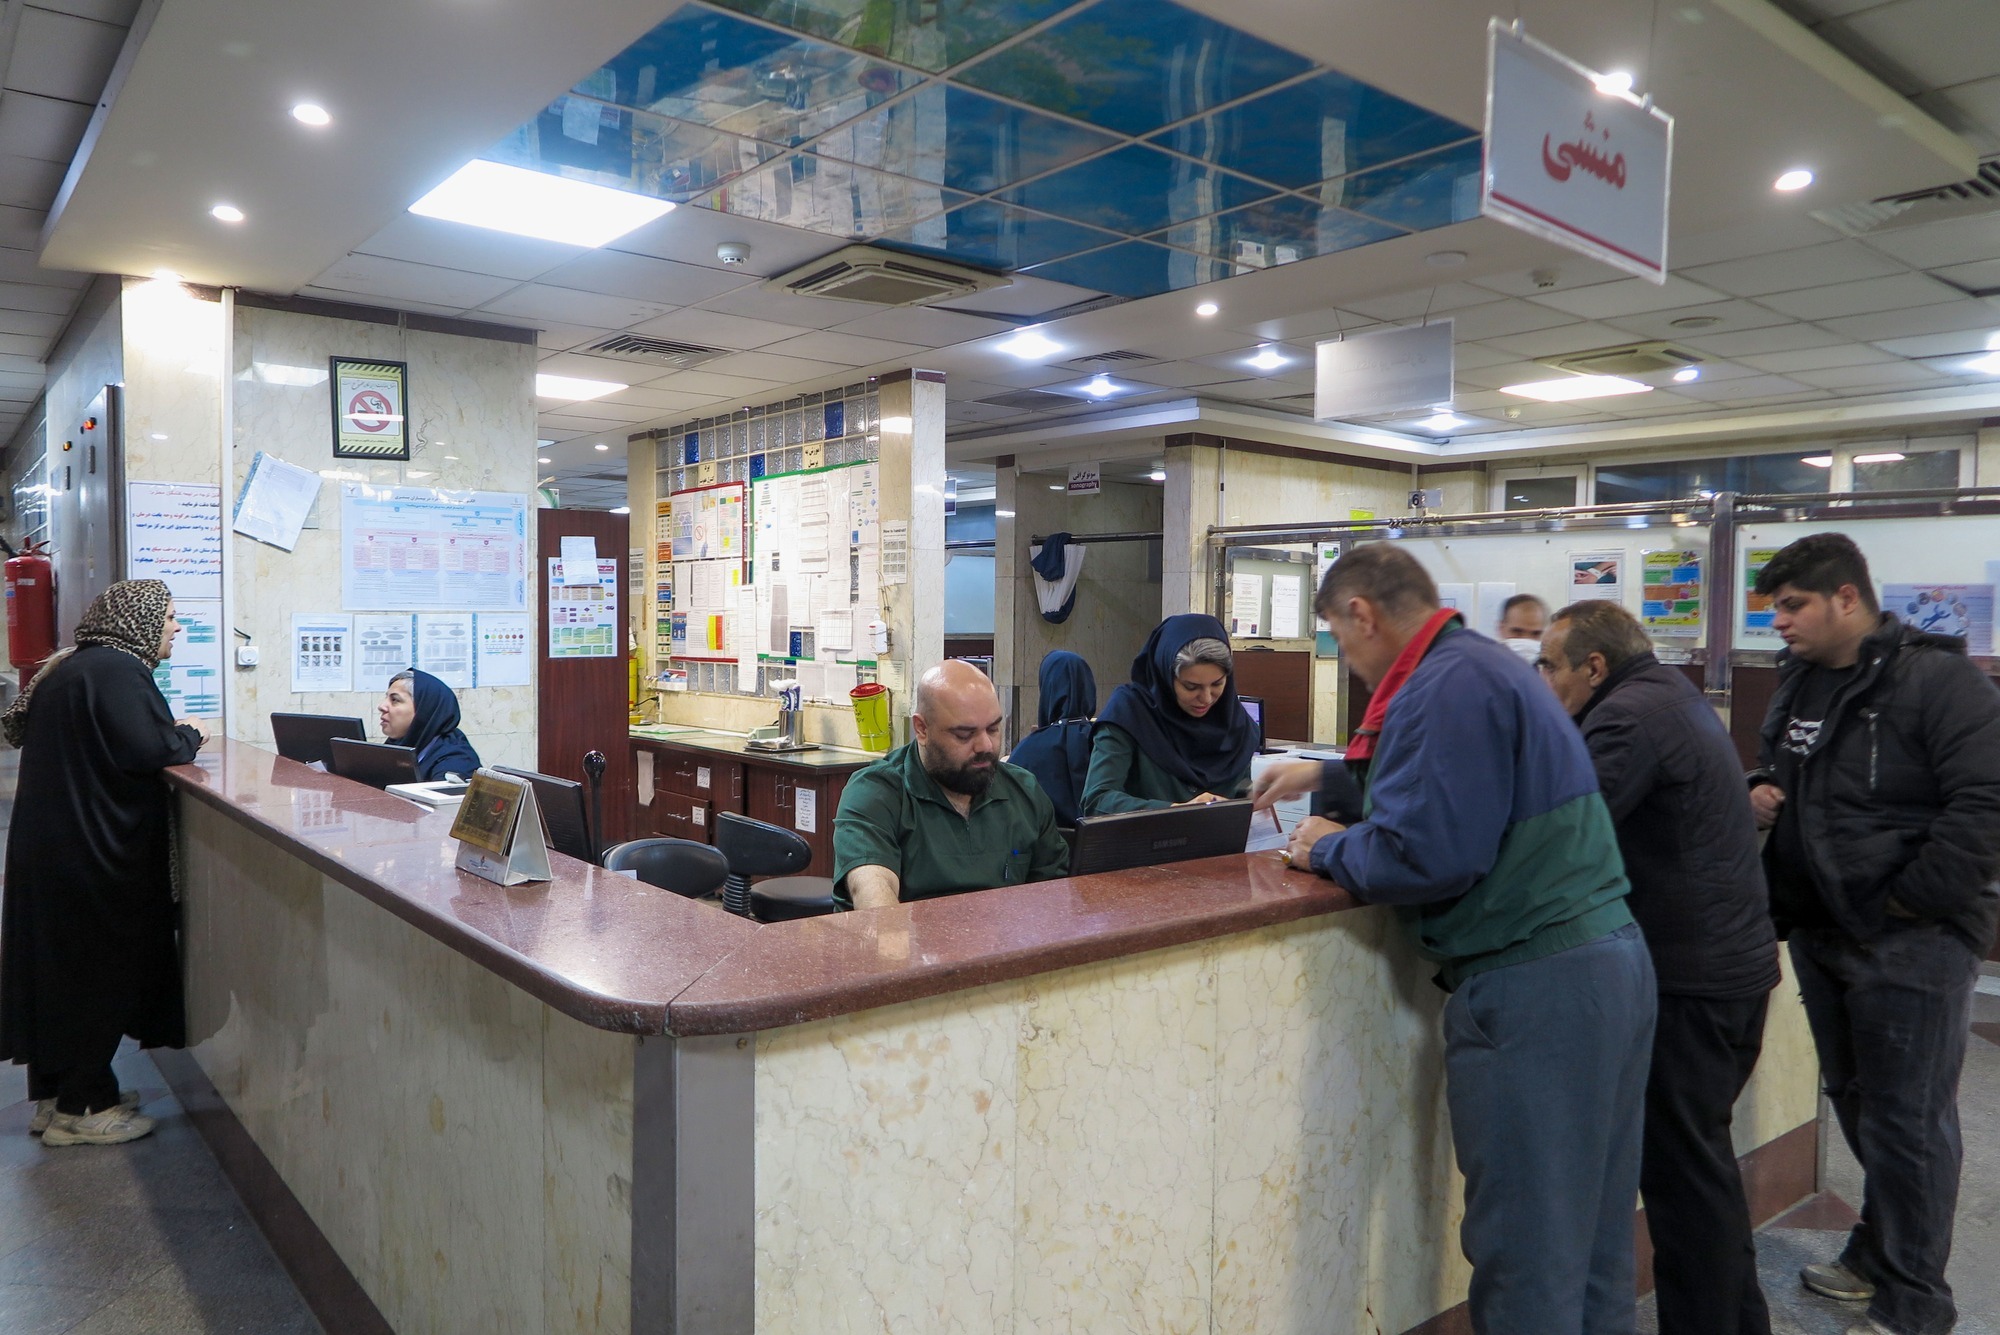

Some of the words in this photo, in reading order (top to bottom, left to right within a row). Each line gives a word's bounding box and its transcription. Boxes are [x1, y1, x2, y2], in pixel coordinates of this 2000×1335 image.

[1542, 109, 1627, 190] منشی
[808, 445, 821, 456] آموزش
[1072, 471, 1096, 480] سونوگرافی
[1412, 493, 1420, 506] 6
[1152, 836, 1189, 850] SAMSUNG
